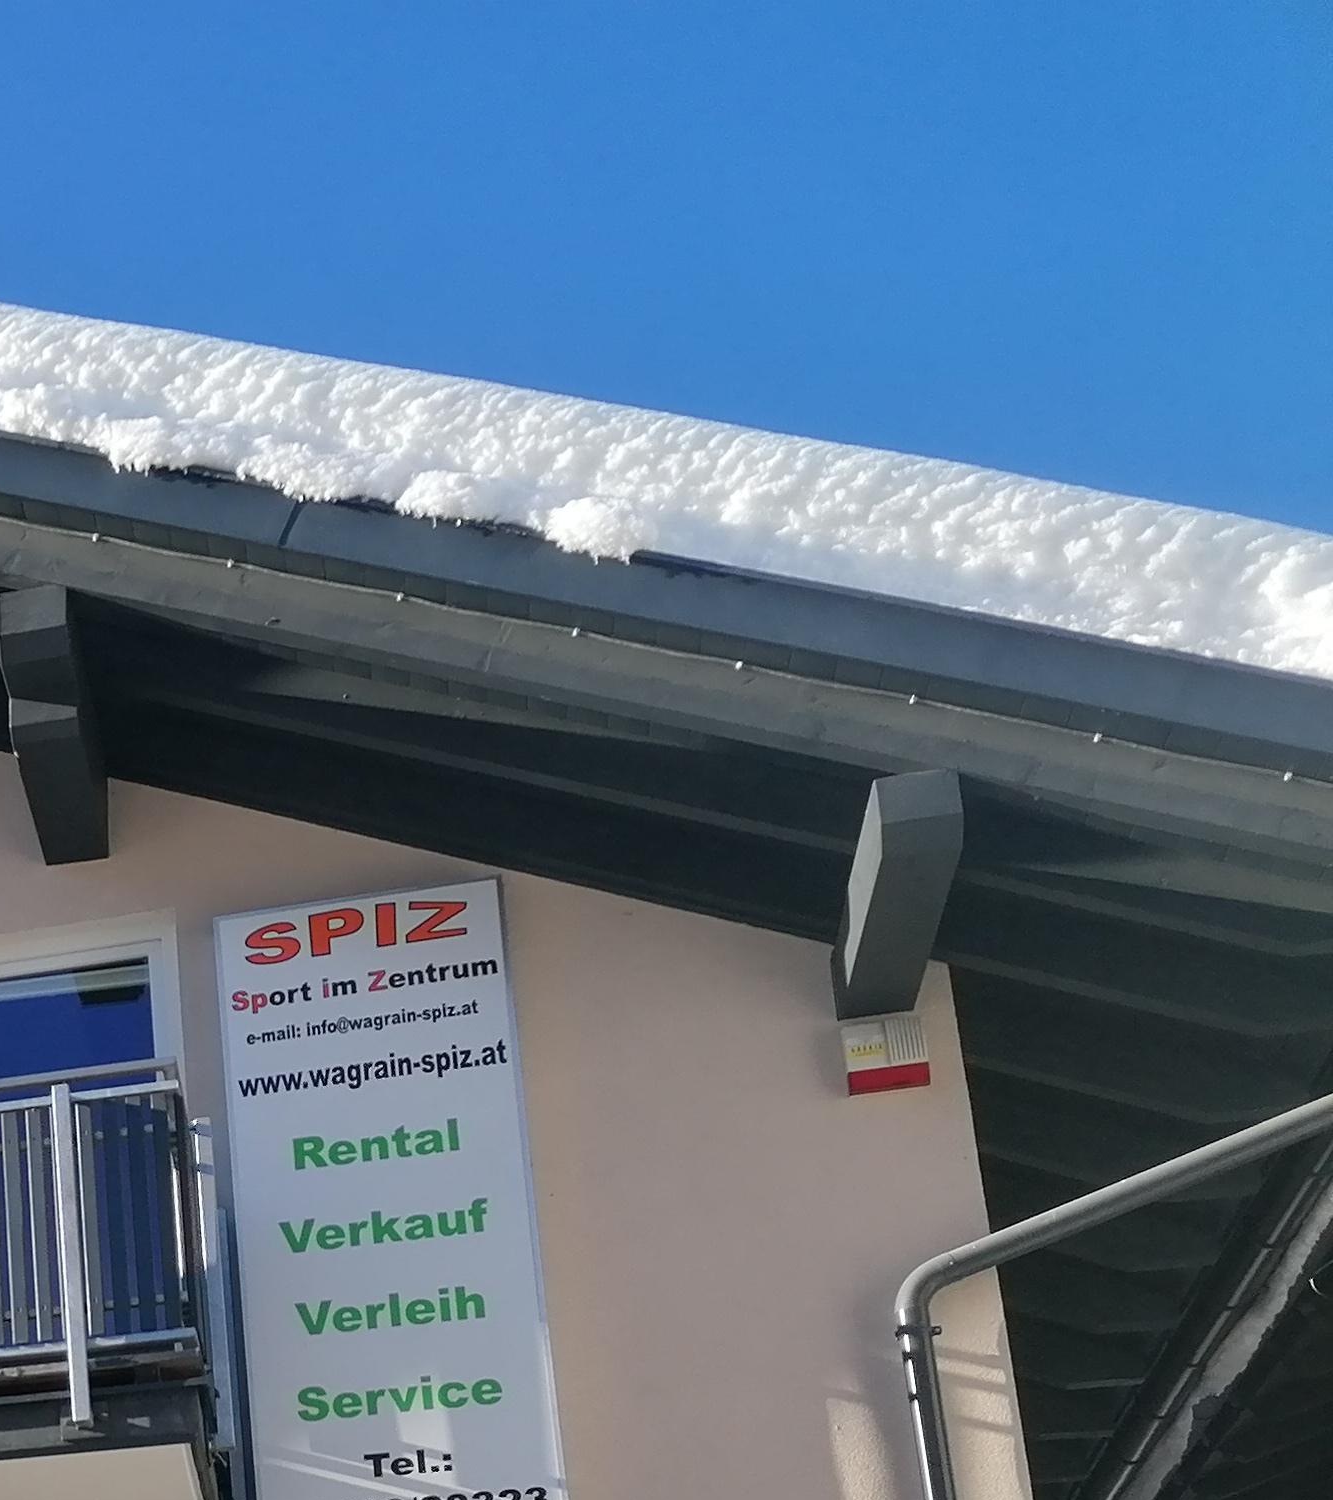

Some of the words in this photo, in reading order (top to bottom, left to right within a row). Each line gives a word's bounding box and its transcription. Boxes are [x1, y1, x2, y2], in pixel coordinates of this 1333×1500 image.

[244, 900, 468, 966] SPIZ
[231, 981, 313, 1014] Sport
[321, 977, 358, 999] im
[367, 958, 499, 993] Zentrum
[246, 1023, 302, 1046] e-mail:
[306, 999, 480, 1037] info@wagrain-spiz.at
[238, 1038, 509, 1098] www.wagrain-spiz.at
[291, 1117, 461, 1172] Rental
[278, 1197, 489, 1254] Verkauf
[293, 1285, 488, 1337] Verleih
[295, 1375, 504, 1424] Service
[363, 1448, 455, 1480] Tel.:
